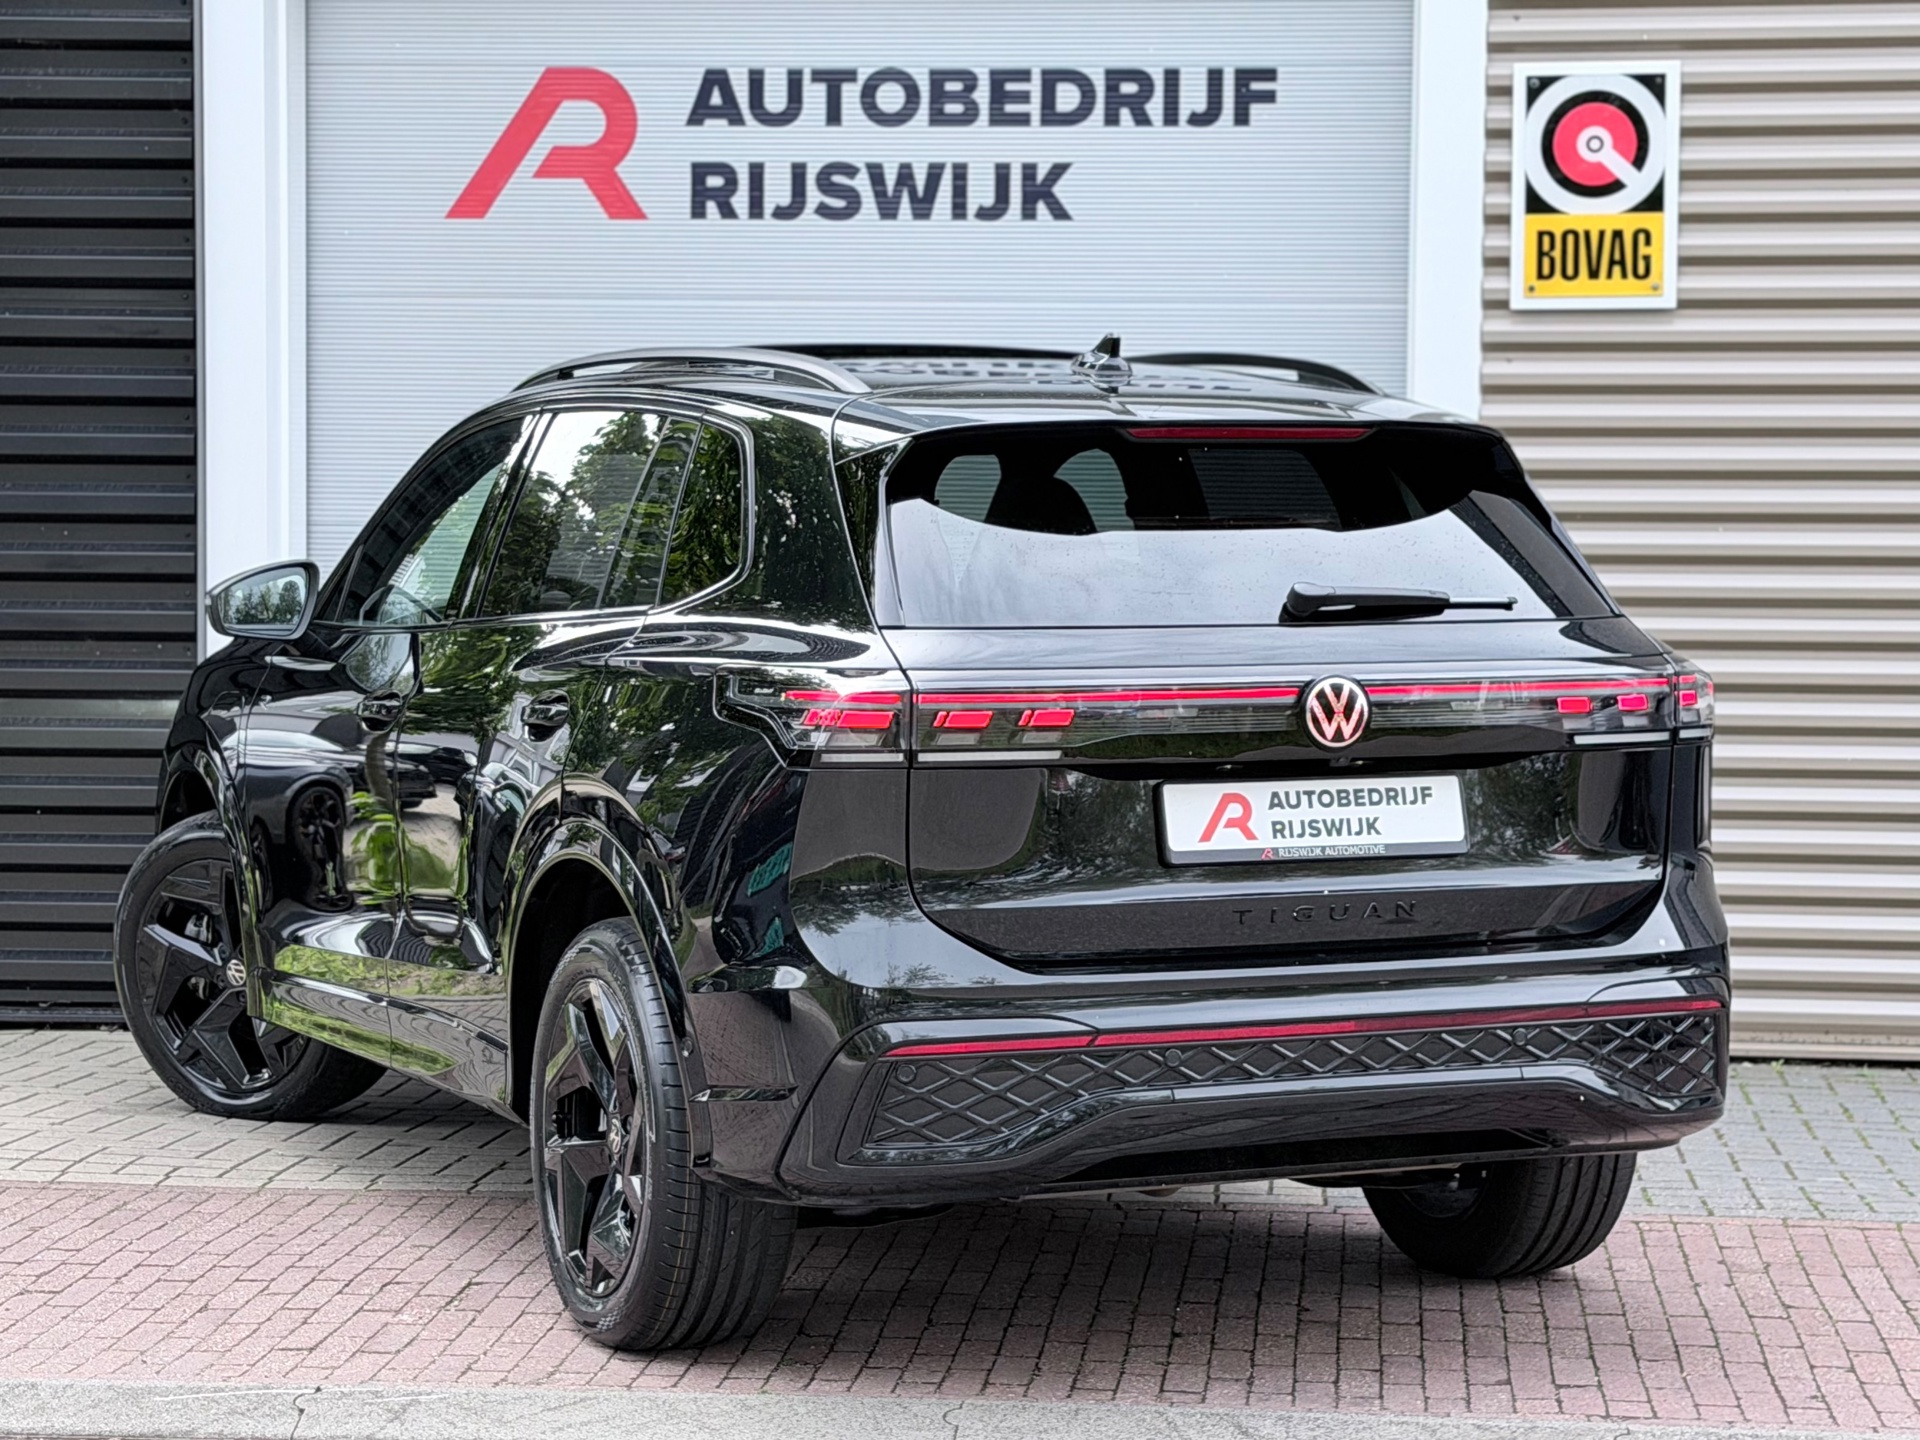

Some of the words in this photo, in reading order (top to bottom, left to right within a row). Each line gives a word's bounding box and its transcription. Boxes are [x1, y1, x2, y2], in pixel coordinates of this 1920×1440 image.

[685, 67, 1278, 127] AUTOBEDRIJF
[690, 160, 1074, 221] RIJSWIJK
[1535, 228, 1653, 282] BOVAG
[1267, 786, 1433, 811] AUTOBEDRIJF
[1271, 816, 1382, 840] RIJSWIJK
[1278, 847, 1323, 858] RIJSWIJK
[1324, 844, 1387, 856] AUTOMOTIVE
[1232, 900, 1416, 925] TIGUAN
